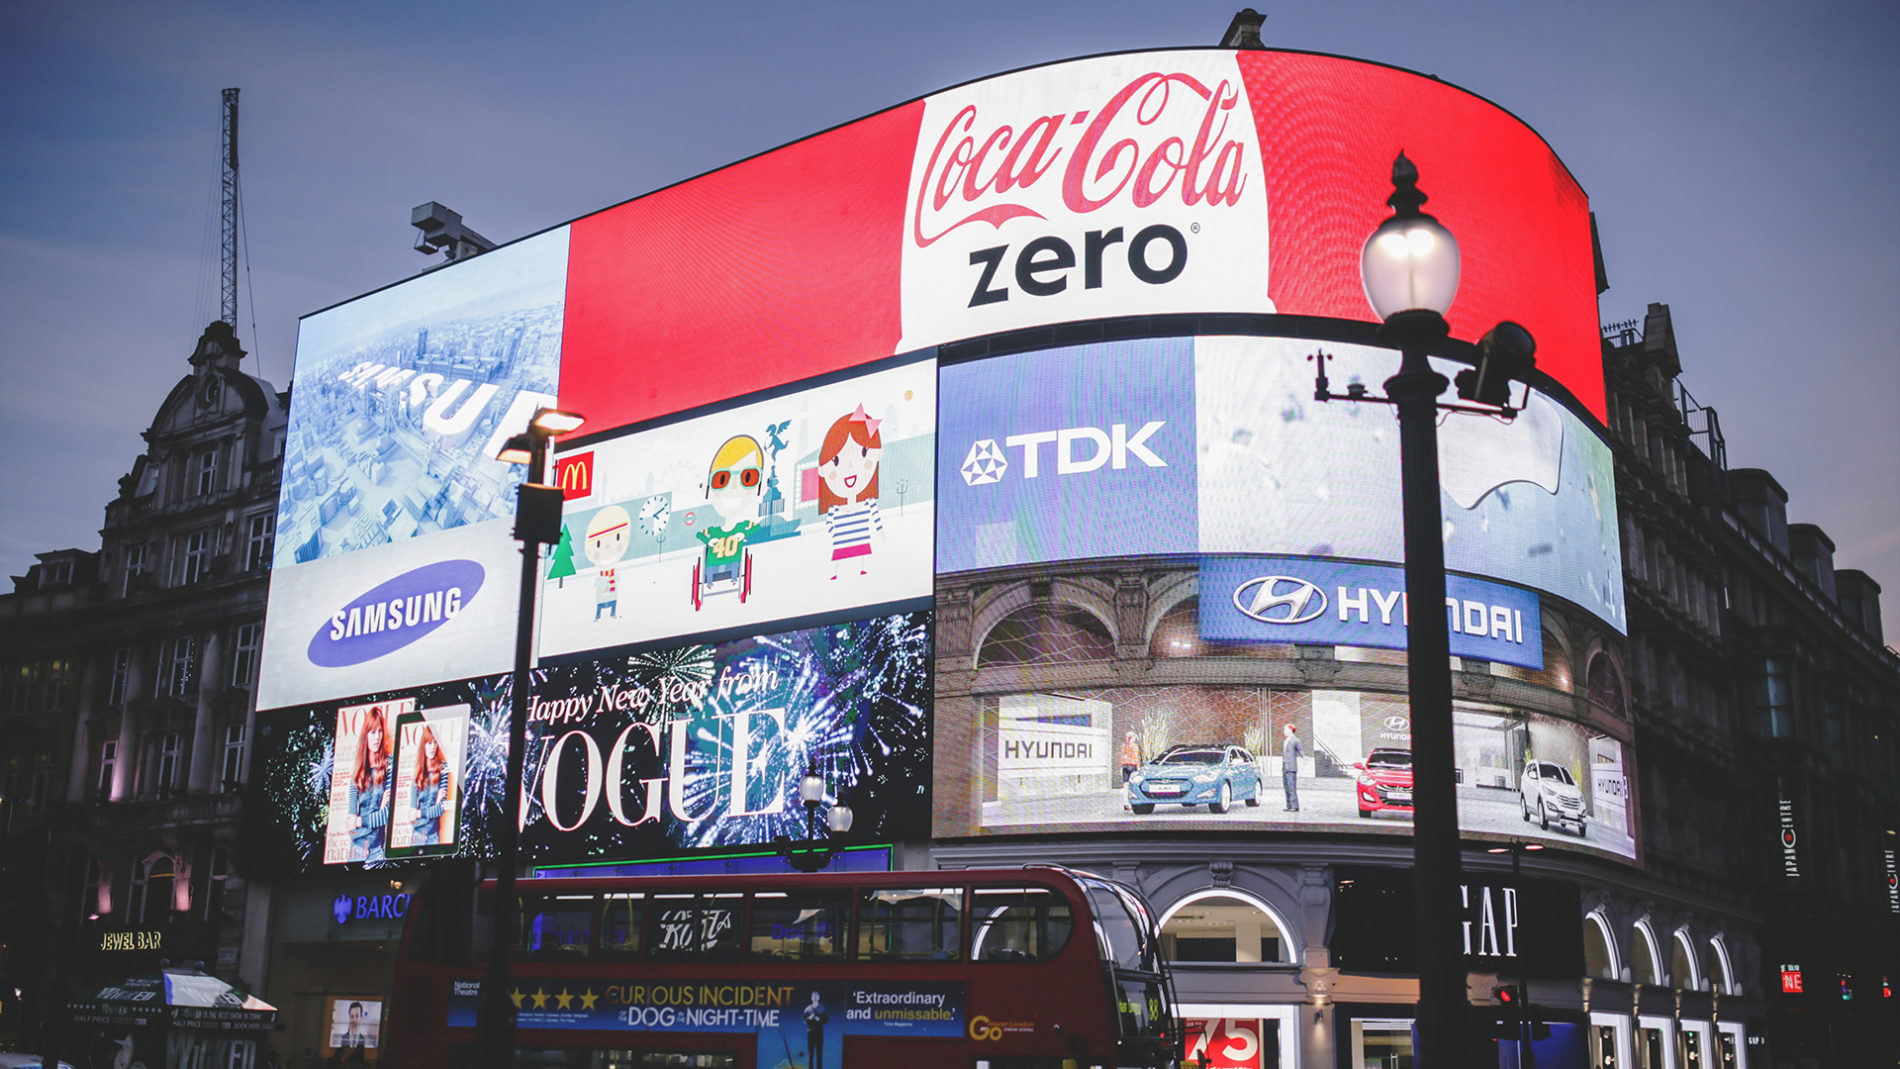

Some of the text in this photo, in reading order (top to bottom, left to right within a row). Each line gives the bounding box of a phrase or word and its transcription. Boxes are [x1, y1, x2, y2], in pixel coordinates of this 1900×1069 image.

[914, 72, 1247, 248] Coca-Cola
[967, 223, 1188, 308] zero
[1006, 421, 1168, 479] TDK
[712, 536, 739, 559] 40
[330, 587, 461, 641] SAMSUNG
[1338, 586, 1523, 644] HYNDAI
[596, 684, 650, 712] New
[658, 675, 713, 706] Year
[716, 665, 779, 703] from
[1005, 740, 1092, 759] HYUNDAI
[1784, 849, 1800, 877] JAPAN
[100, 931, 162, 951] JEWEL BAR
[605, 985, 795, 1007] CURIOUS INCIDENT
[627, 1006, 675, 1027] DOG
[686, 1007, 780, 1028] NIGHT-TIME
[846, 1007, 871, 1020] and
[1149, 998, 1159, 1022] 88
[969, 1015, 1003, 1041] Go
[1186, 1018, 1258, 1062] 75
